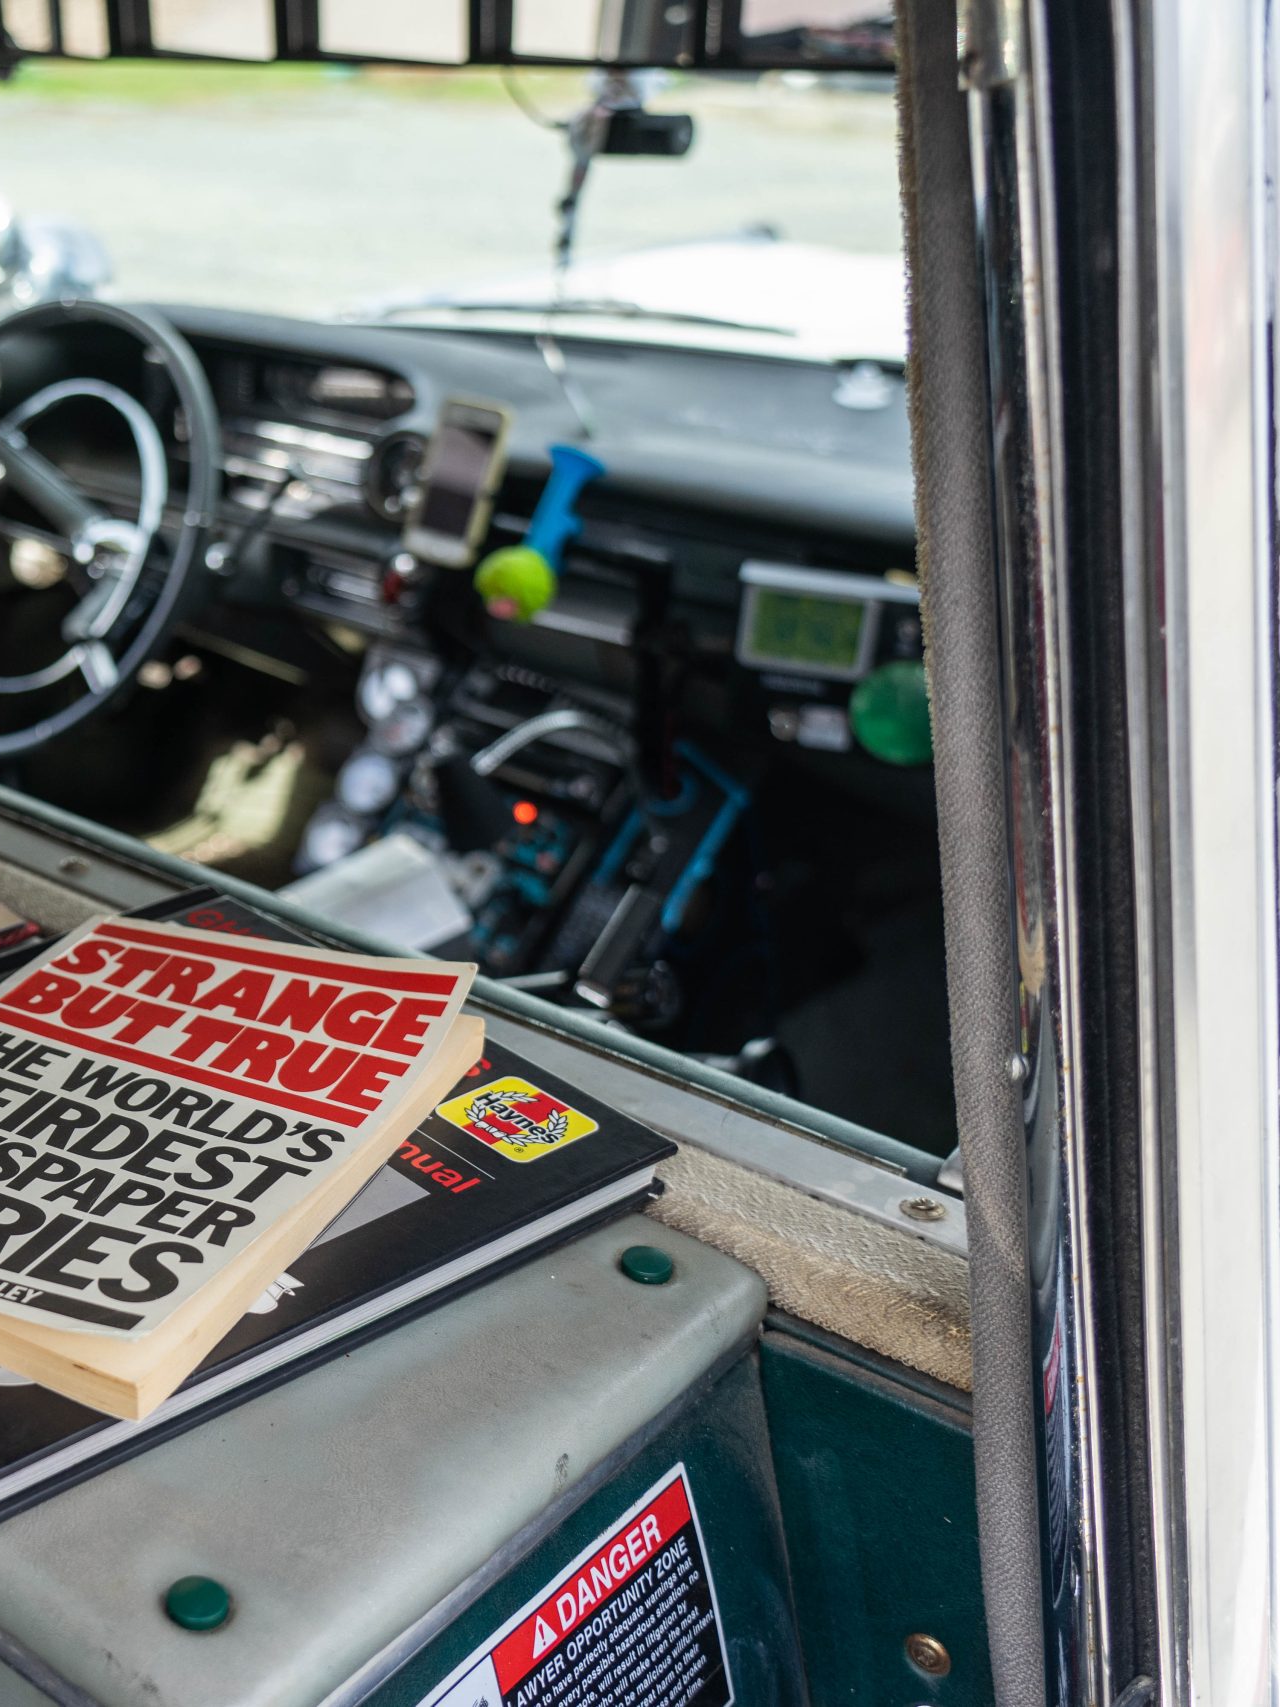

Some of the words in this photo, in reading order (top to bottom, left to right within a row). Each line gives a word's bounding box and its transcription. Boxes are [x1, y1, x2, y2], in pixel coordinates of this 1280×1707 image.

[0, 969, 187, 1045] BUT
[170, 1014, 411, 1112] TRUE
[50, 939, 448, 1057] STRANGE
[60, 1058, 345, 1162] WORLD'S
[473, 1091, 560, 1144] Haynes
[399, 1140, 481, 1194] nual
[555, 1513, 662, 1632] DANGER
[566, 1568, 653, 1661] OPPORTUNITY
[654, 1536, 689, 1580] ZONE
[542, 1693, 552, 1706] to
[552, 1672, 573, 1697] have
[573, 1637, 608, 1680] perfectly
[608, 1605, 644, 1643] adequate
[644, 1572, 678, 1609] warnings
[676, 1556, 693, 1576] that
[558, 1685, 581, 1707] every
[581, 1652, 616, 1692] possible
[615, 1614, 656, 1656] hazardous
[655, 1582, 689, 1618] situation,
[688, 1570, 699, 1585] no
[576, 1691, 598, 1707] ote,
[598, 1671, 613, 1693] will
[613, 1650, 637, 1679] result
[636, 1643, 646, 1656] in
[645, 1611, 678, 1648] litigation
[676, 1600, 687, 1615] by
[613, 1676, 629, 1697] will
[628, 1657, 651, 1683] make
[650, 1638, 669, 1662] even
[668, 1626, 681, 1643] the
[680, 1605, 699, 1630] most
[624, 1691, 636, 1706] be
[636, 1654, 672, 1696] malicious
[671, 1629, 693, 1659] willful
[692, 1609, 714, 1637] intent
[637, 1688, 657, 1707] reat
[656, 1670, 676, 1695] harm
[674, 1661, 684, 1675] to
[682, 1643, 700, 1665] their
[669, 1679, 683, 1700] and
[682, 1654, 707, 1686] broken
